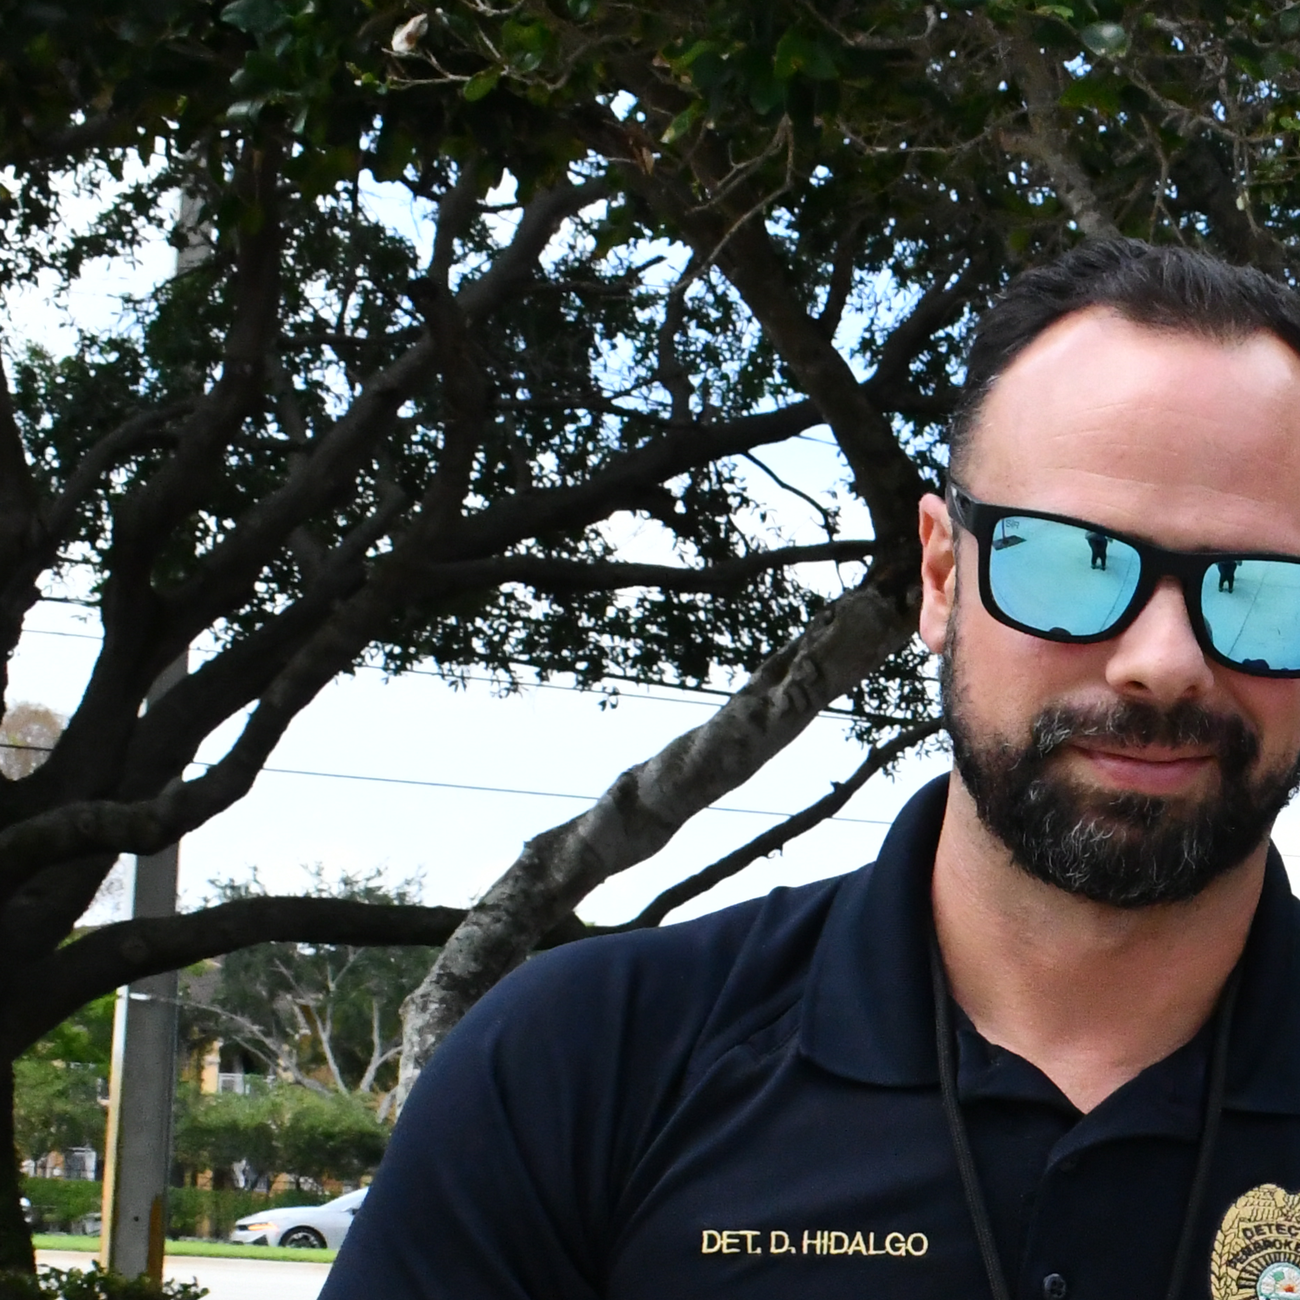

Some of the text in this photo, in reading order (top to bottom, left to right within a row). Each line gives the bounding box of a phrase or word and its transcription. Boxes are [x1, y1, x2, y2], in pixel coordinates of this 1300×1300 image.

[701, 1230, 929, 1256] DET. D. HIDALGO
